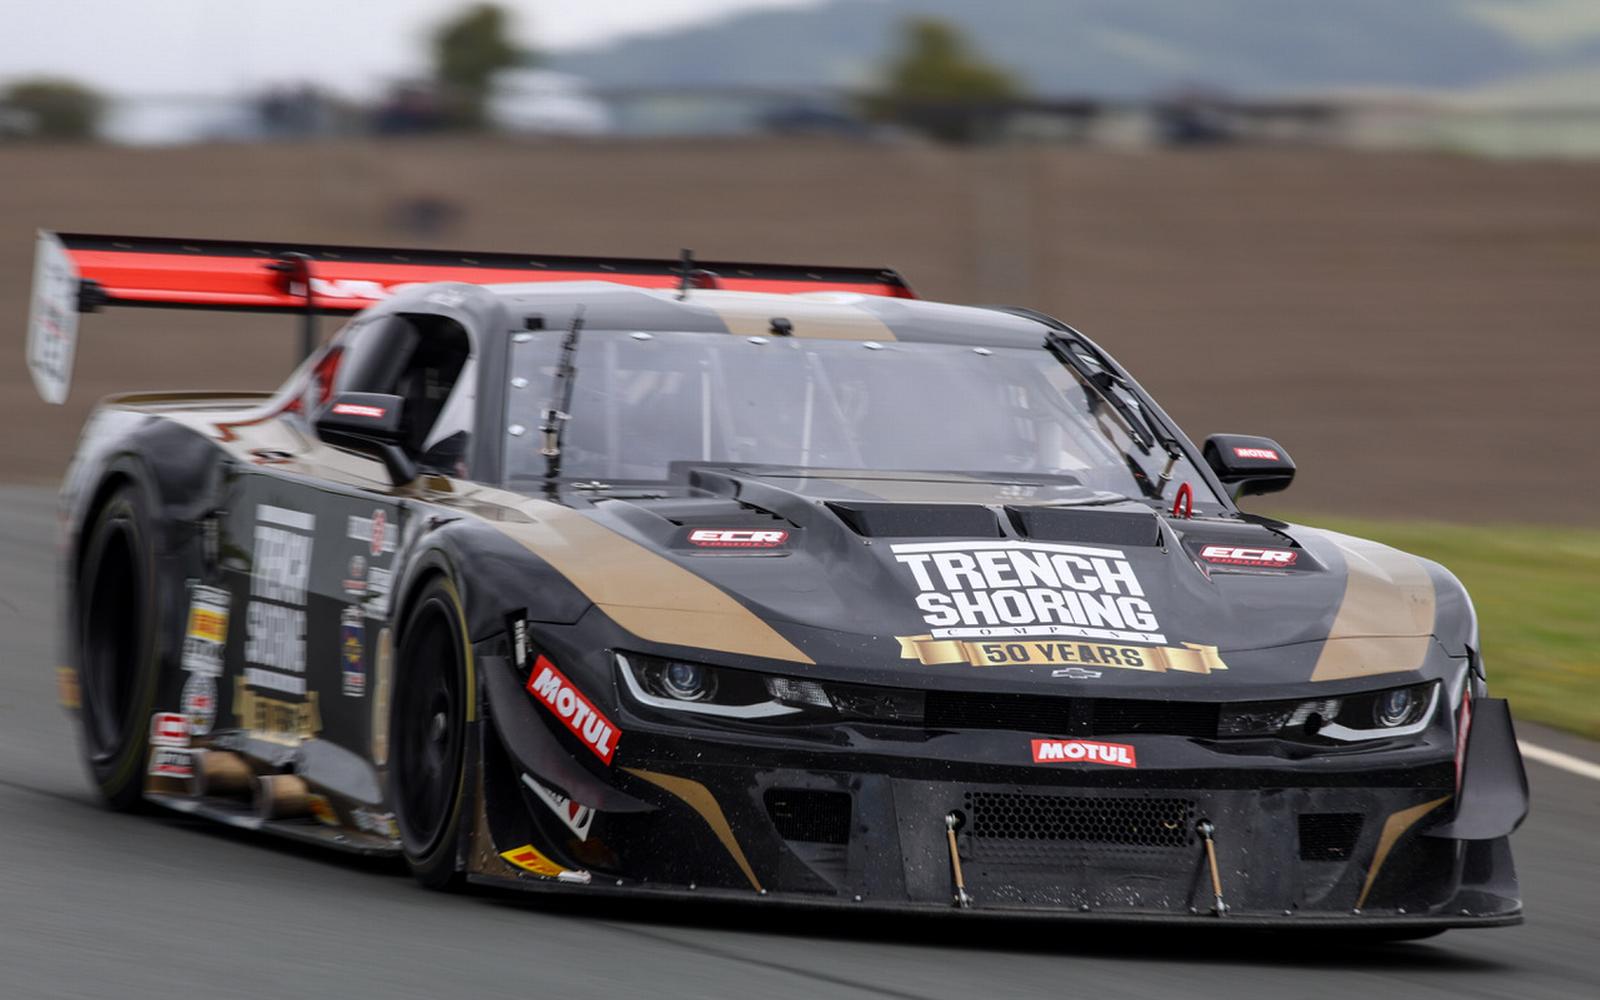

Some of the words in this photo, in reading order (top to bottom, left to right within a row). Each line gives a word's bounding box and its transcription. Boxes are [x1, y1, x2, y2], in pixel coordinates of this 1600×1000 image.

[1237, 448, 1279, 461] MOTUL
[690, 530, 785, 543] ECR
[1202, 546, 1294, 562] ECR
[894, 550, 1146, 597] TRENCH
[914, 587, 1160, 632] SHORING
[946, 626, 1153, 641] COMPANY
[984, 643, 1028, 663] 50
[1035, 643, 1144, 667] YEARS
[531, 665, 613, 757] MOTUL
[1038, 742, 1132, 764] MOTUL
